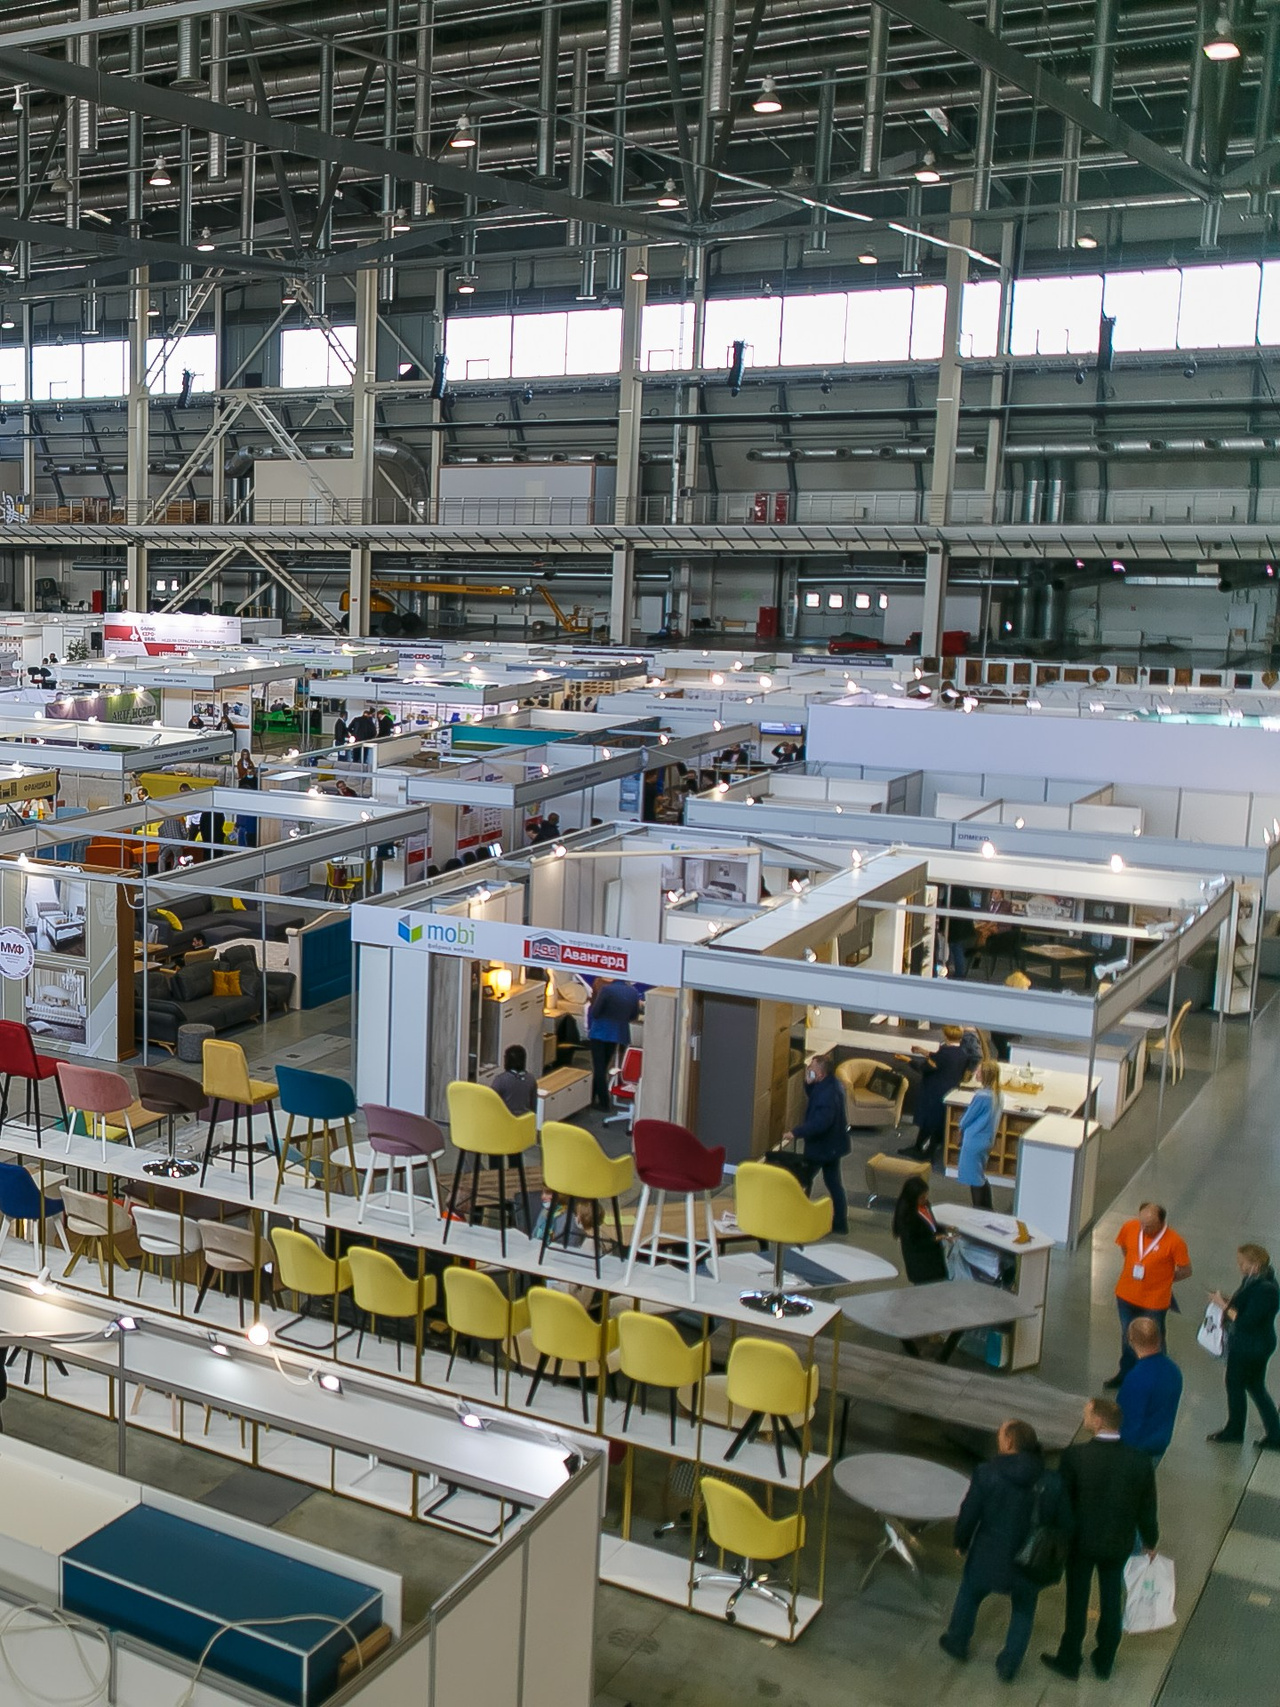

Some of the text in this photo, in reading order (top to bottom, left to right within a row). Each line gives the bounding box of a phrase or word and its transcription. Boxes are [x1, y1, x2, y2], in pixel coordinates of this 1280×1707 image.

[23, 780, 52, 793] ФРАНШИЗА
[427, 921, 475, 945] mobi
[1, 941, 24, 955] ММФ
[563, 947, 626, 969] Авангард
